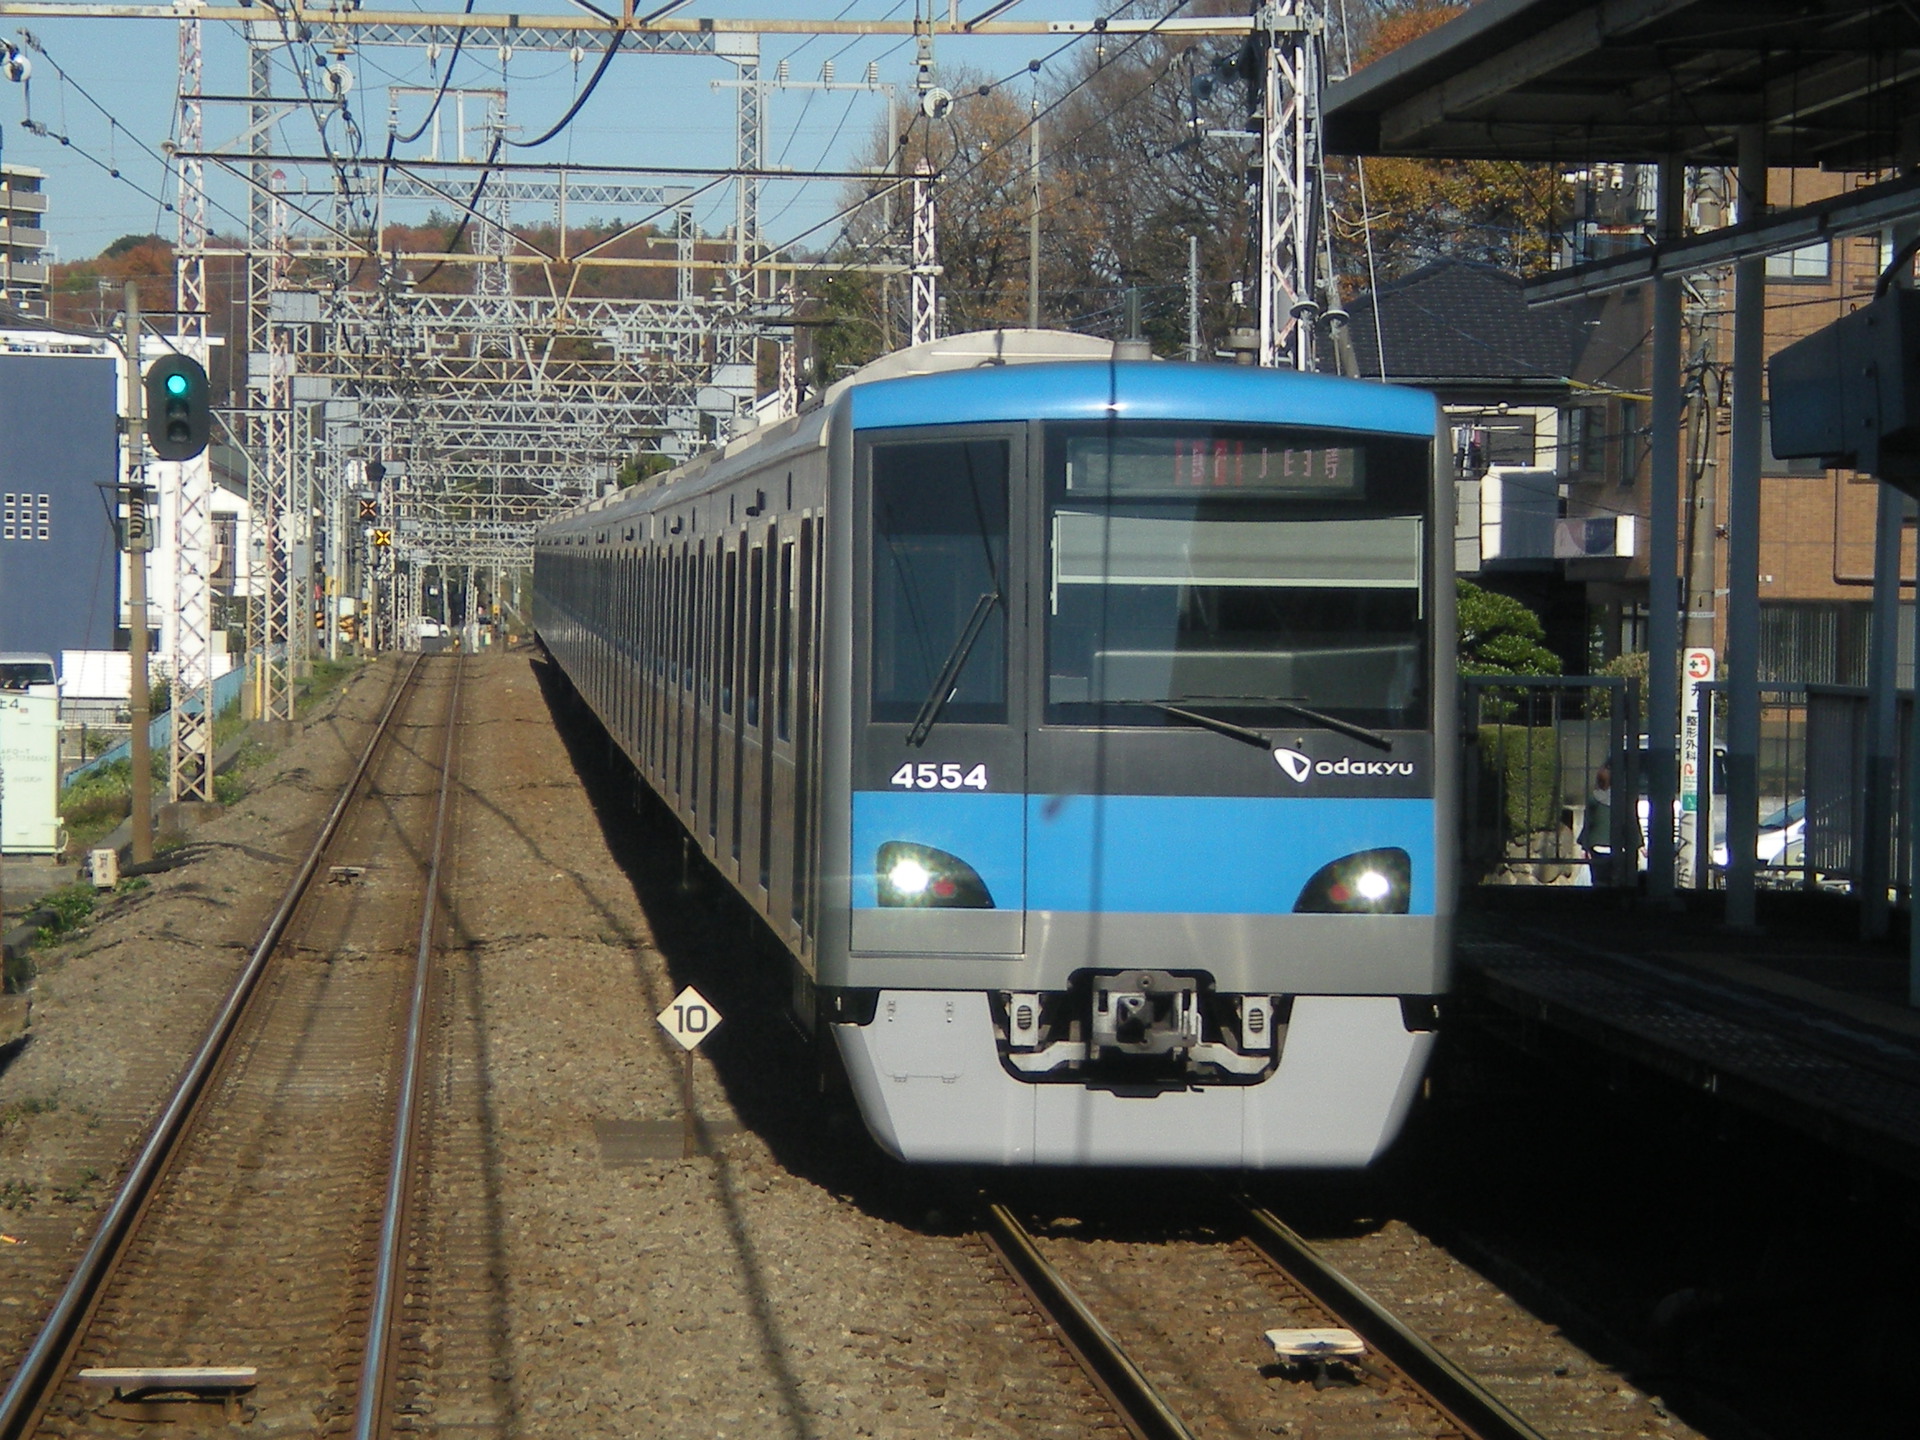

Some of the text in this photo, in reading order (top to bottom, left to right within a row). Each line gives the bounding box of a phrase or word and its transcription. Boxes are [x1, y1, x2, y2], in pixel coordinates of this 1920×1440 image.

[129, 465, 144, 484] 4
[891, 763, 988, 790] 4554
[1315, 757, 1414, 775] odakyu
[673, 1005, 708, 1034] 10
